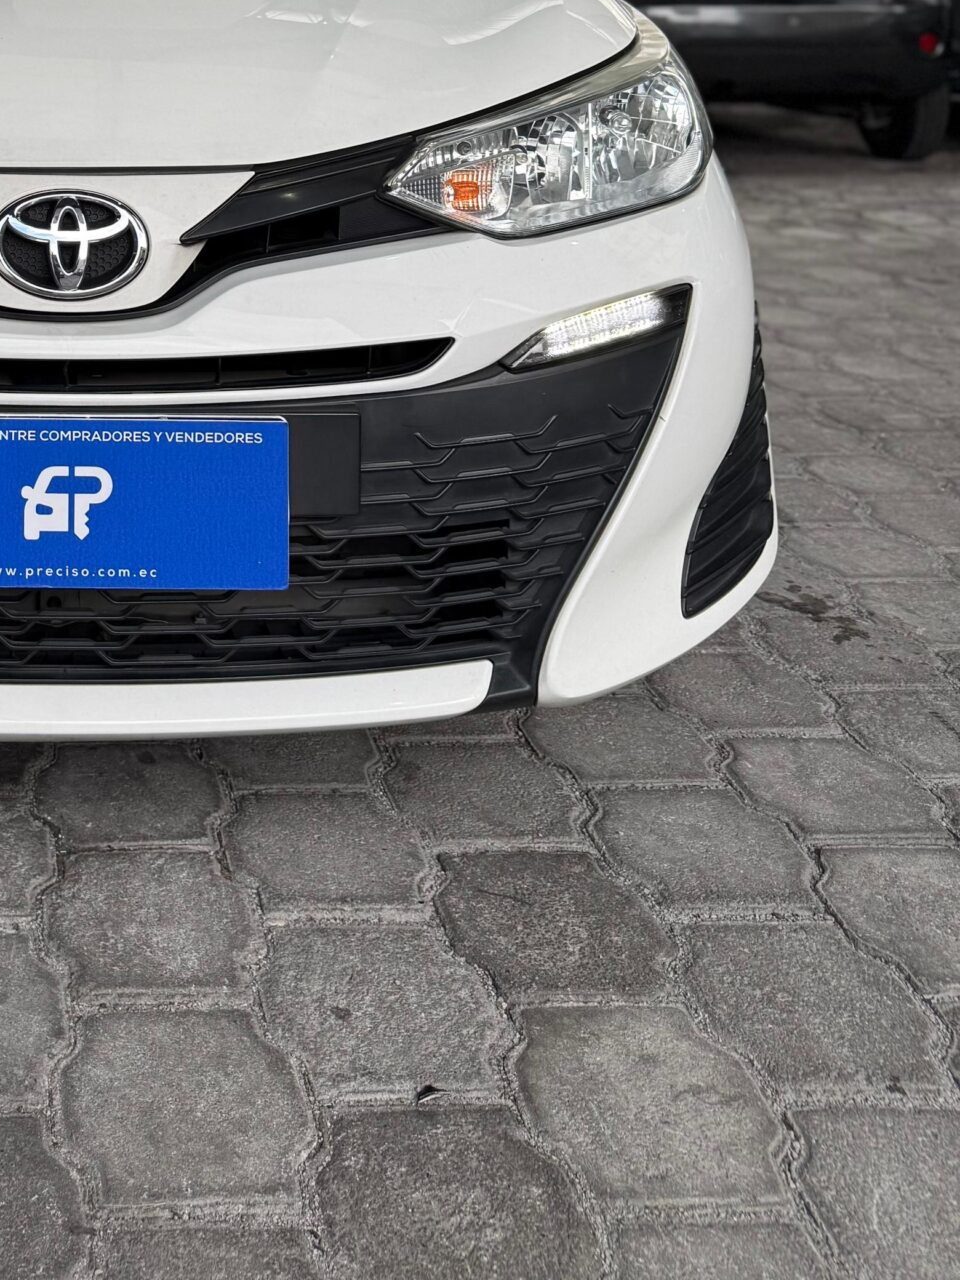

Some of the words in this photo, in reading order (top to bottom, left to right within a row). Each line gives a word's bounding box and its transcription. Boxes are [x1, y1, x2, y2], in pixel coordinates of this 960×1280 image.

[39, 430, 151, 443] COMPRADORES
[153, 431, 163, 442] Y
[164, 432, 263, 444] VENDEDORES
